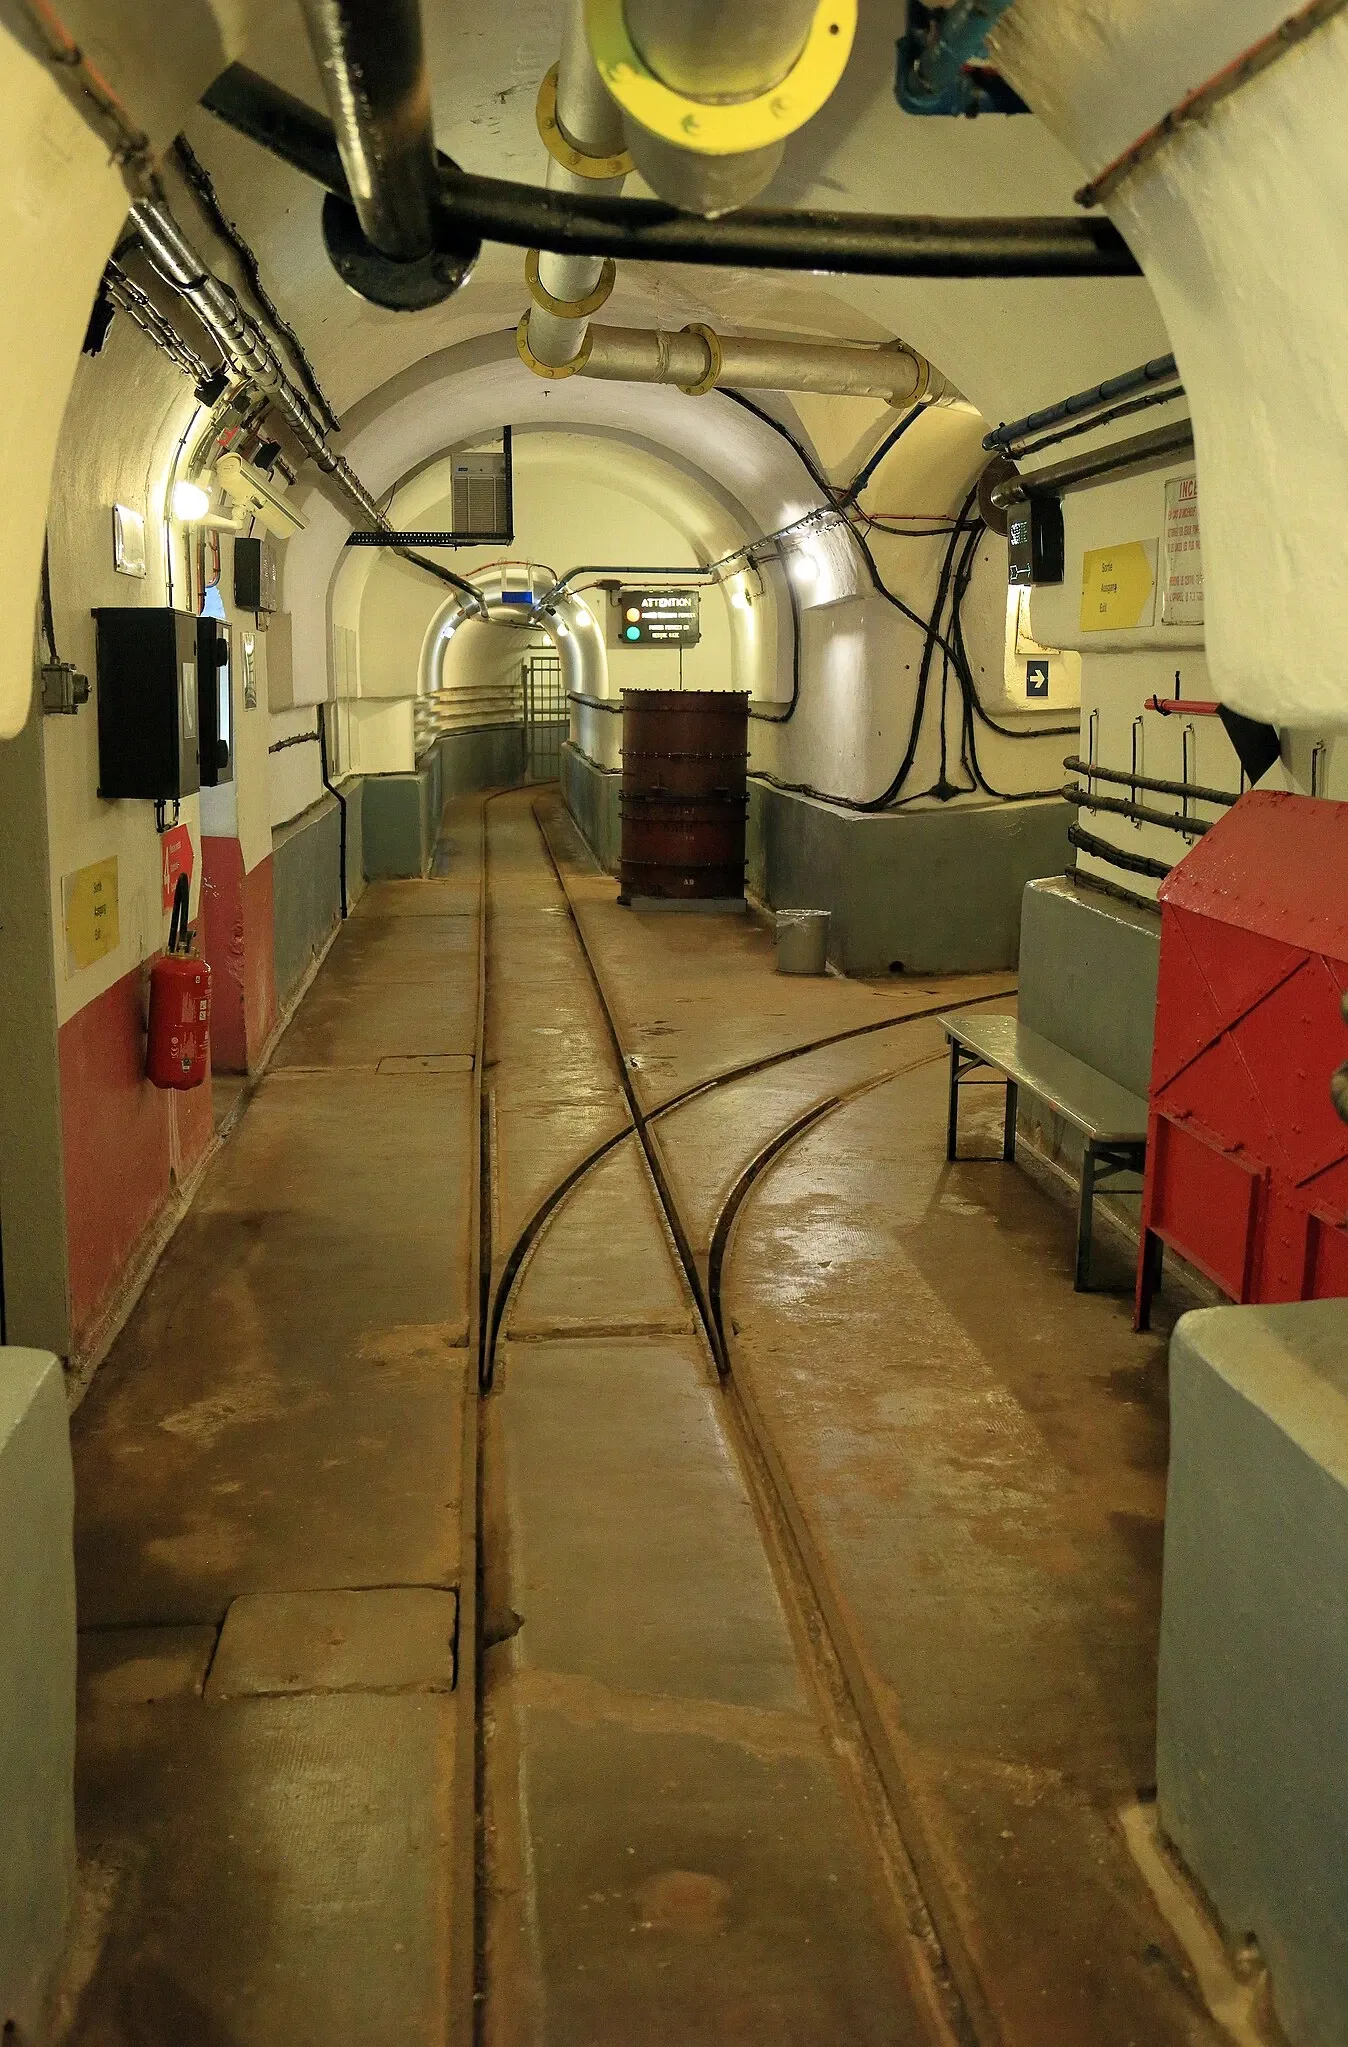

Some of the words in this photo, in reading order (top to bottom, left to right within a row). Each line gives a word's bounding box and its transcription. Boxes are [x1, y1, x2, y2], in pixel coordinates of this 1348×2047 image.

[1101, 562, 1112, 573] Sortie
[641, 597, 692, 608] ATTENTION
[1099, 602, 1108, 613] Exit
